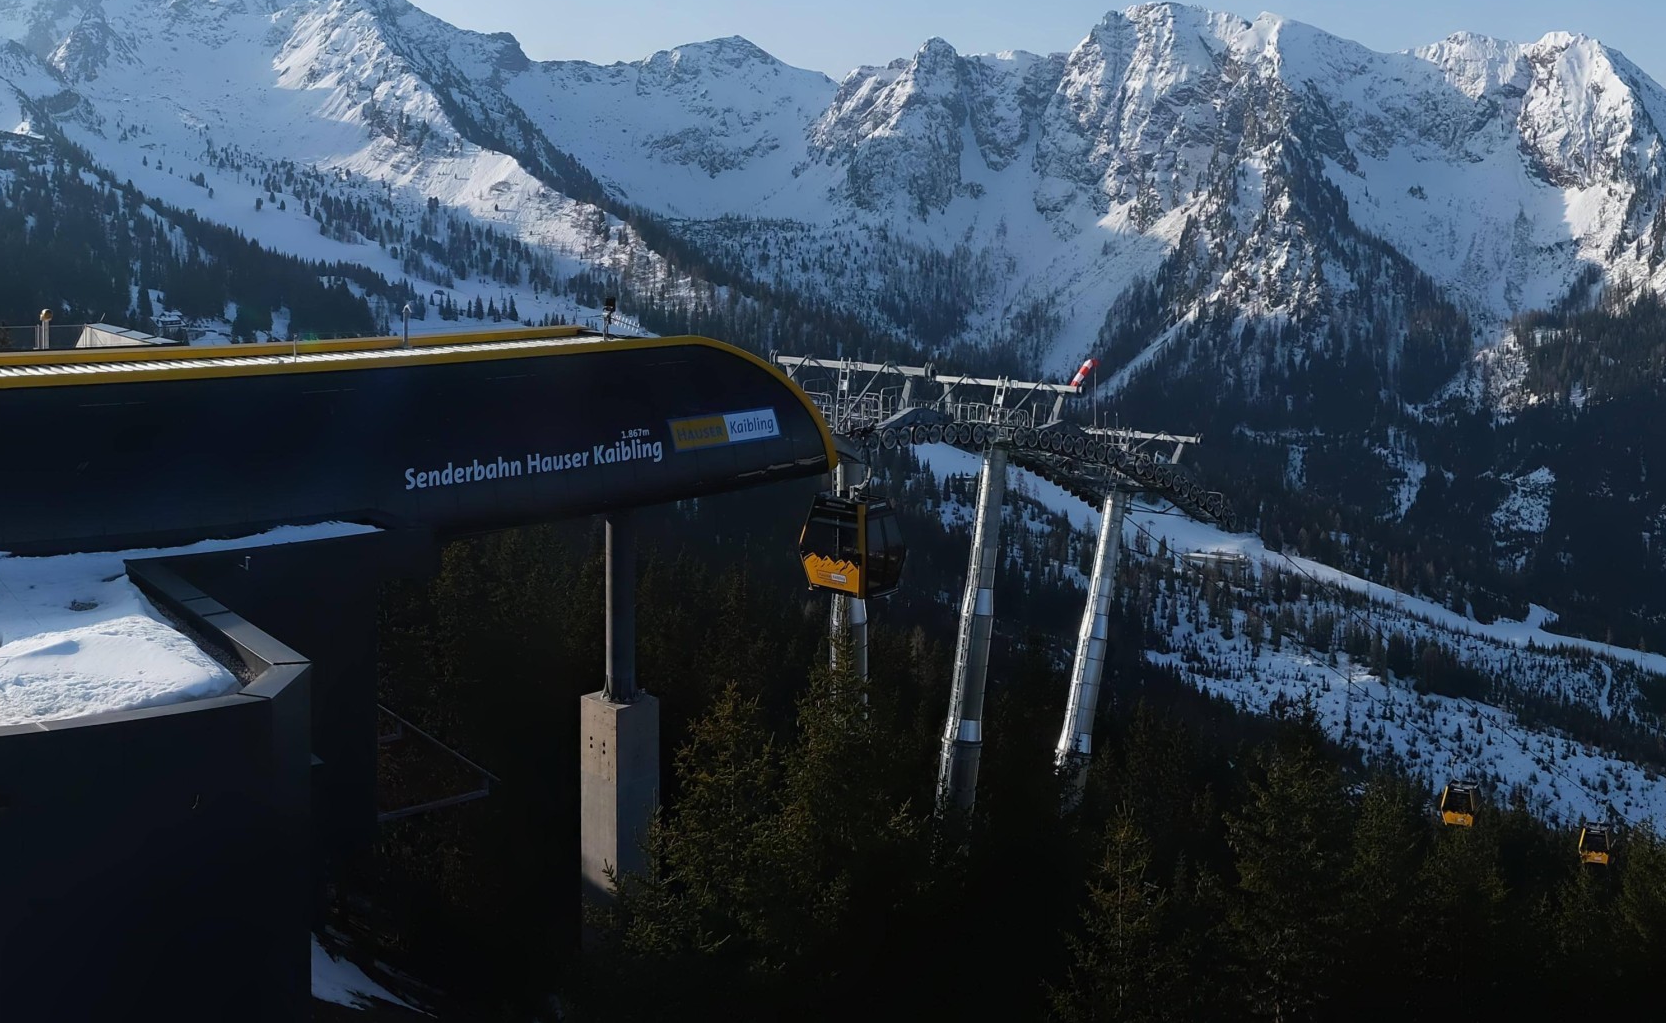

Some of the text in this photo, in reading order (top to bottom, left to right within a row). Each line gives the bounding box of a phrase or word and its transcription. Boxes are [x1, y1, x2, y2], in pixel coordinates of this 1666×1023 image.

[621, 428, 650, 439] 1.867m
[730, 416, 774, 435] Kaibling
[405, 439, 663, 490] Senderbahn Hauser Kaibling
